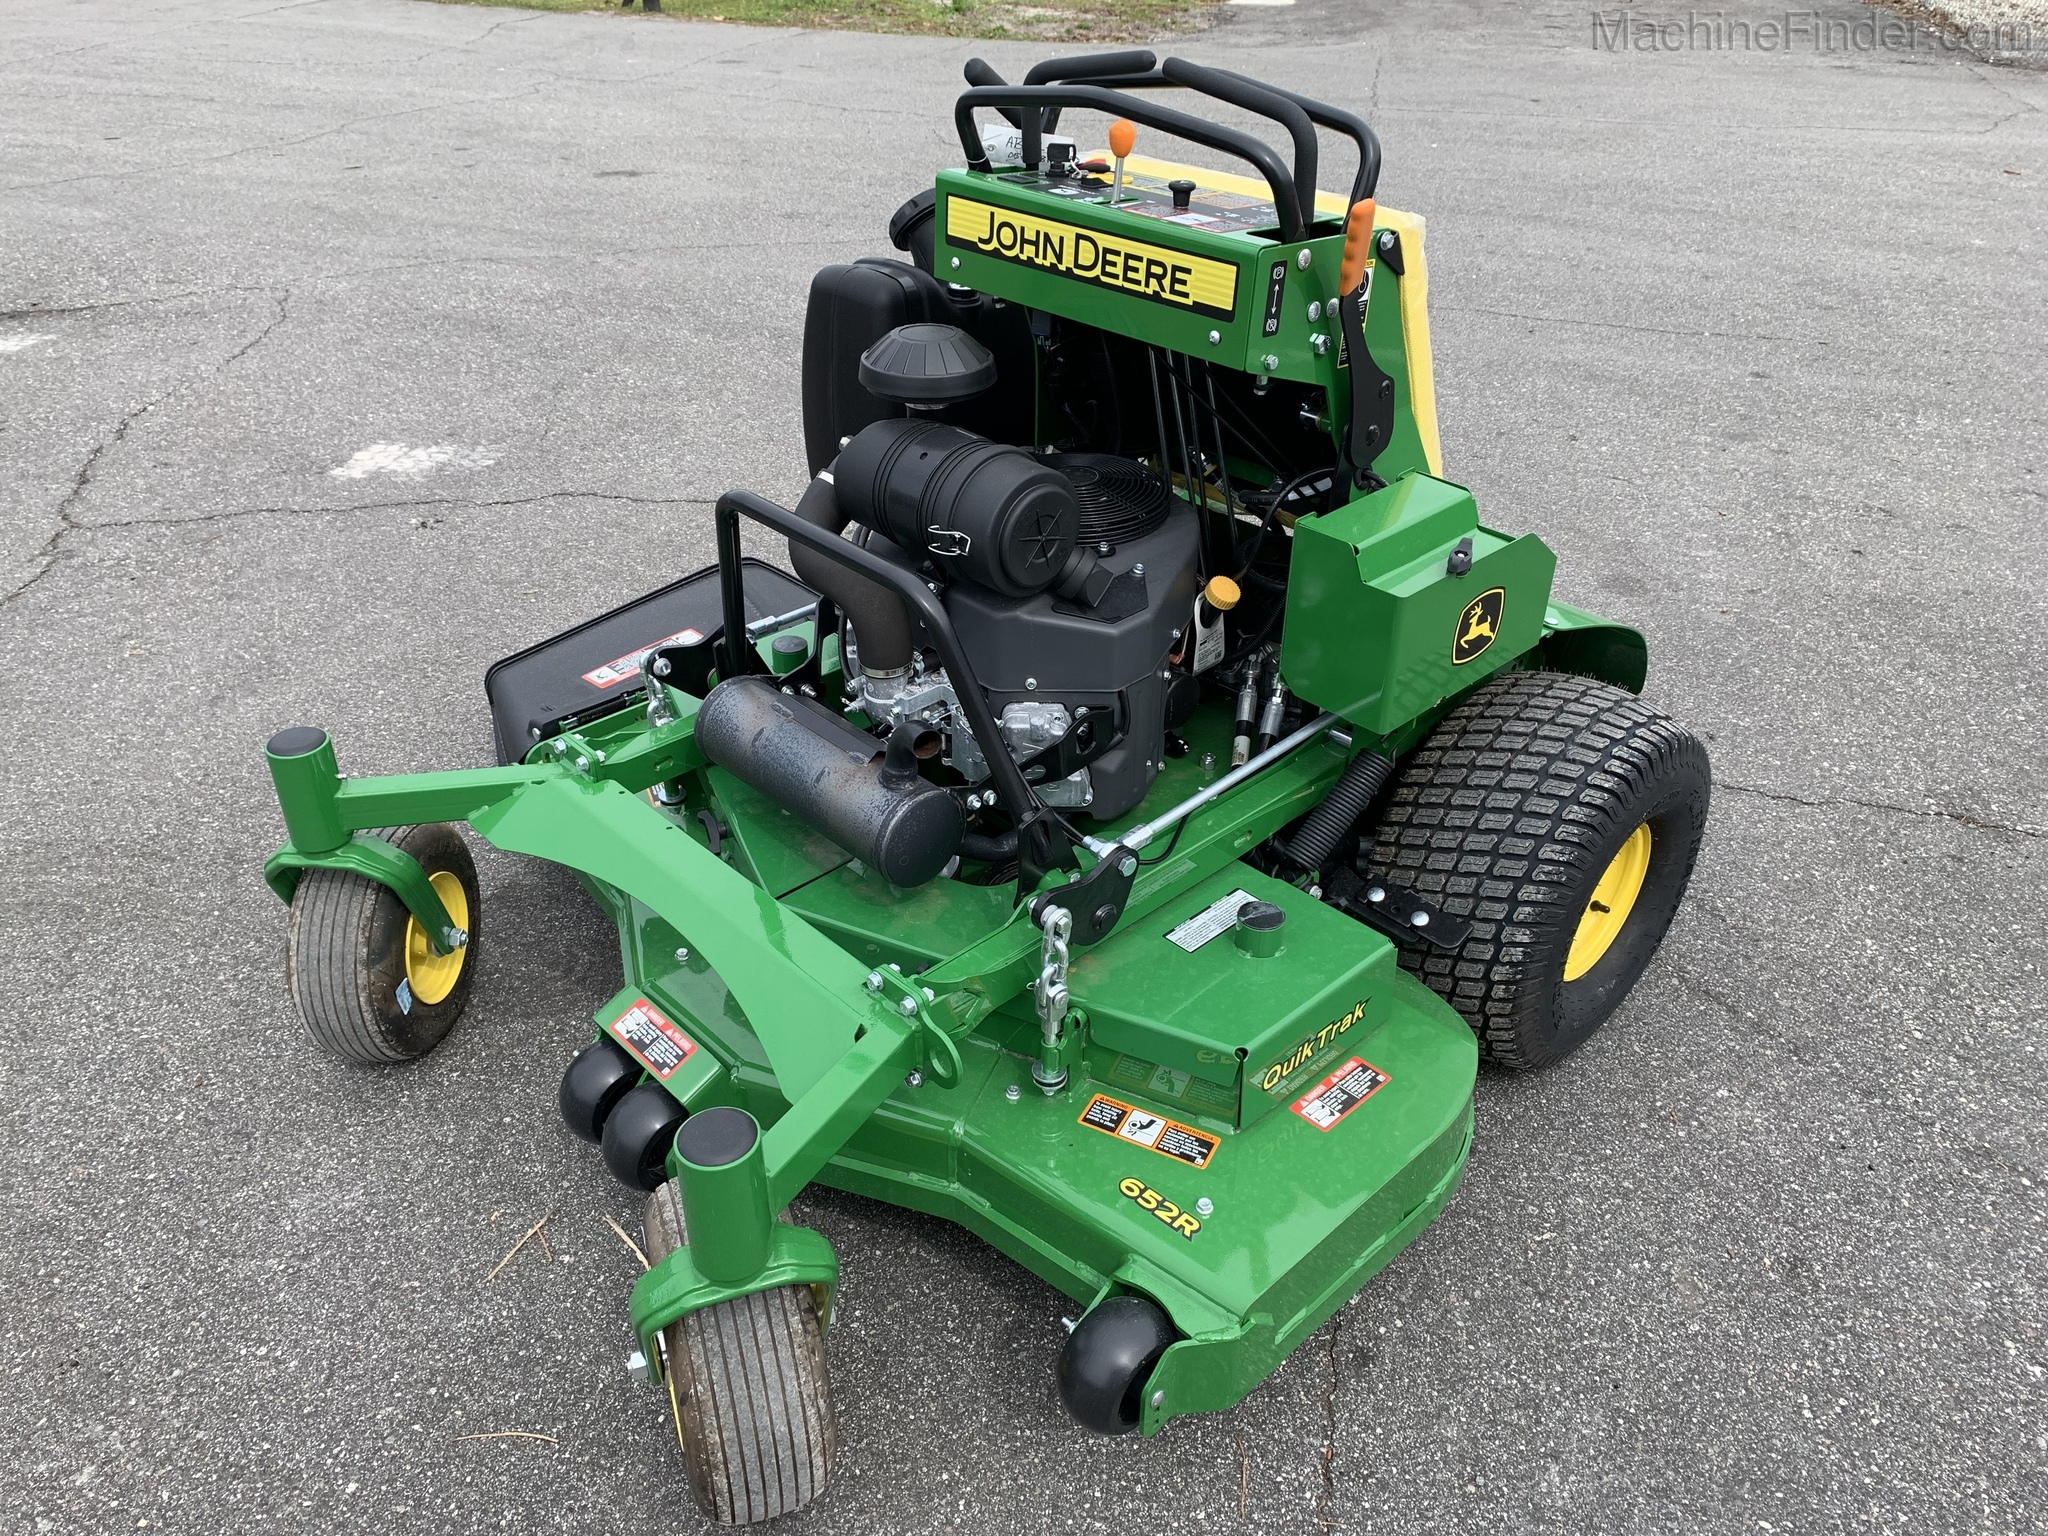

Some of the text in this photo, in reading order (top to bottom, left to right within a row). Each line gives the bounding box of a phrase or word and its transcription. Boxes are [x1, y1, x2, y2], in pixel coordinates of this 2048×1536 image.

[977, 211, 1065, 266] JOHN
[1073, 231, 1193, 301] DEERE
[1105, 1098, 1128, 1109] WARNING
[1180, 1125, 1214, 1141] ADVERTENCIA
[1119, 1177, 1201, 1241] 652R
